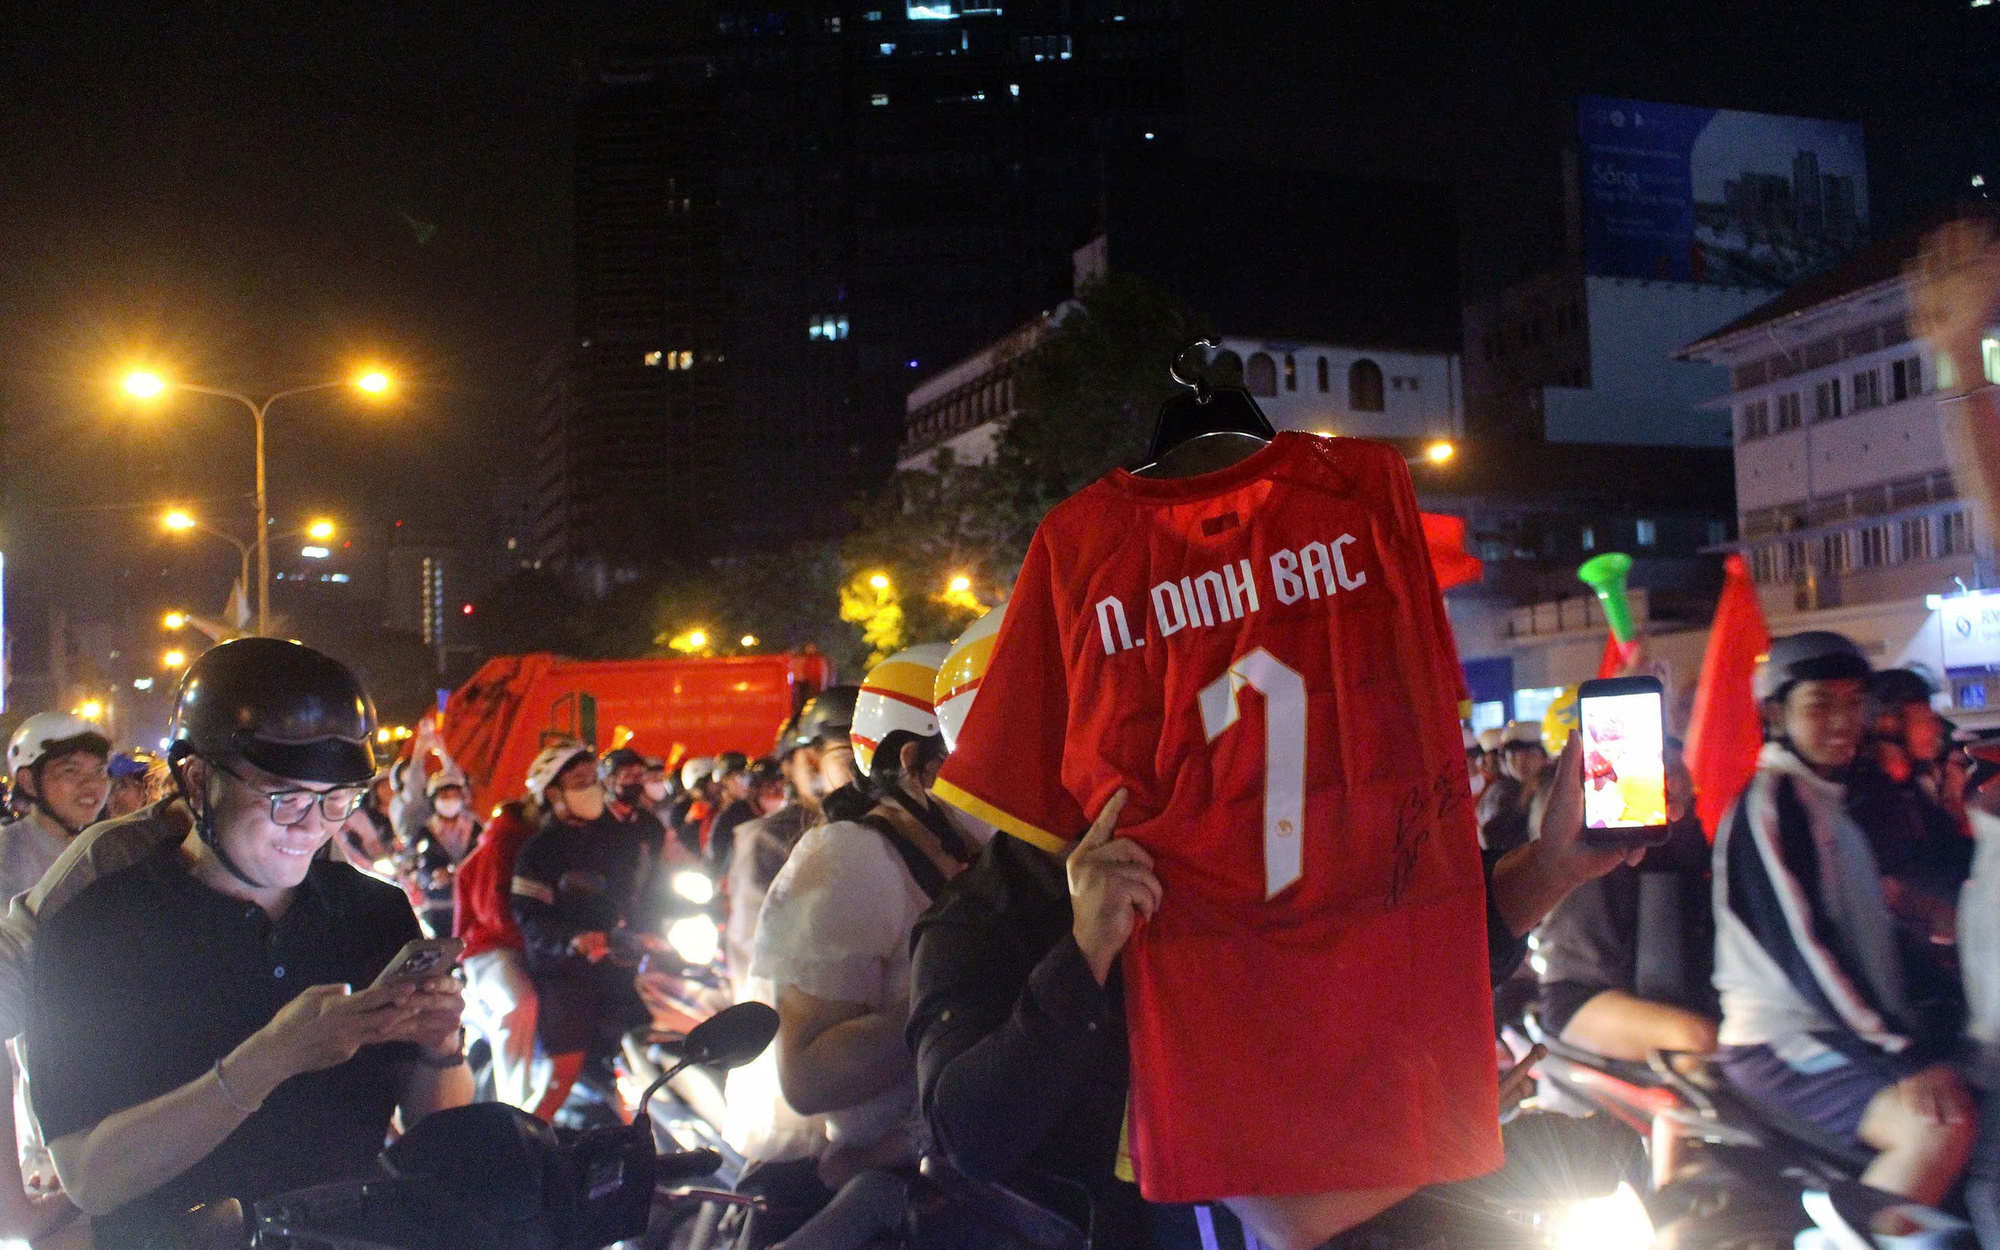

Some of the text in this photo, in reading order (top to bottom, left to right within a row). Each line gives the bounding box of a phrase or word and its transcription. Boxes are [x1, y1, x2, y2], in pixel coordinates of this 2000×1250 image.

[1095, 533, 1367, 656] N. DINH BAC
[1197, 646, 1308, 901] 7
